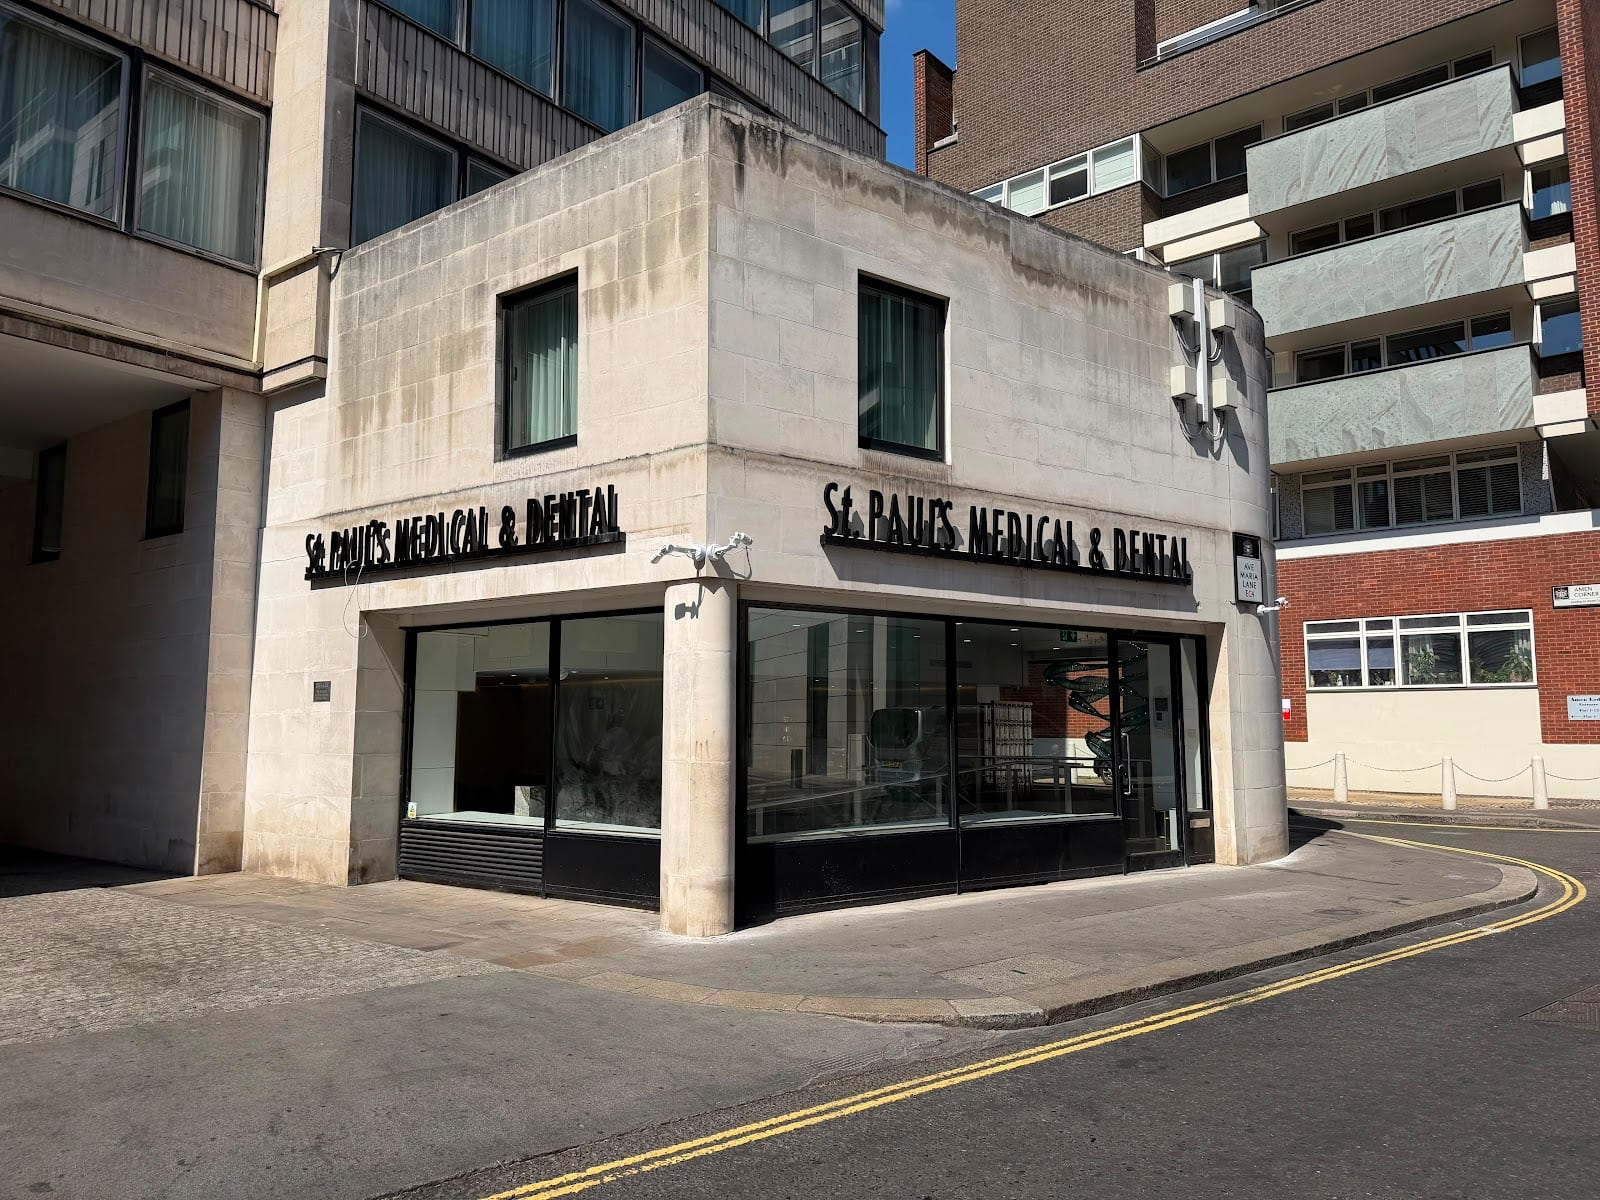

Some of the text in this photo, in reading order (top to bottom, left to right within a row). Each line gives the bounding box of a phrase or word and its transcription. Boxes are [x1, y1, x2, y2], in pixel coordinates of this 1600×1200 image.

[393, 506, 489, 562] MEDICAL
[500, 505, 518, 547] &
[526, 484, 621, 544] DENTAL
[869, 489, 957, 550] PAUL'S
[969, 505, 1080, 567] MEDICAL
[1089, 527, 1105, 569] &
[1113, 527, 1192, 579] DENTAL
[1244, 563, 1254, 571] AVE
[1240, 572, 1259, 580] MARIA
[1242, 580, 1256, 589] LANE
[1246, 590, 1254, 598] EC4
